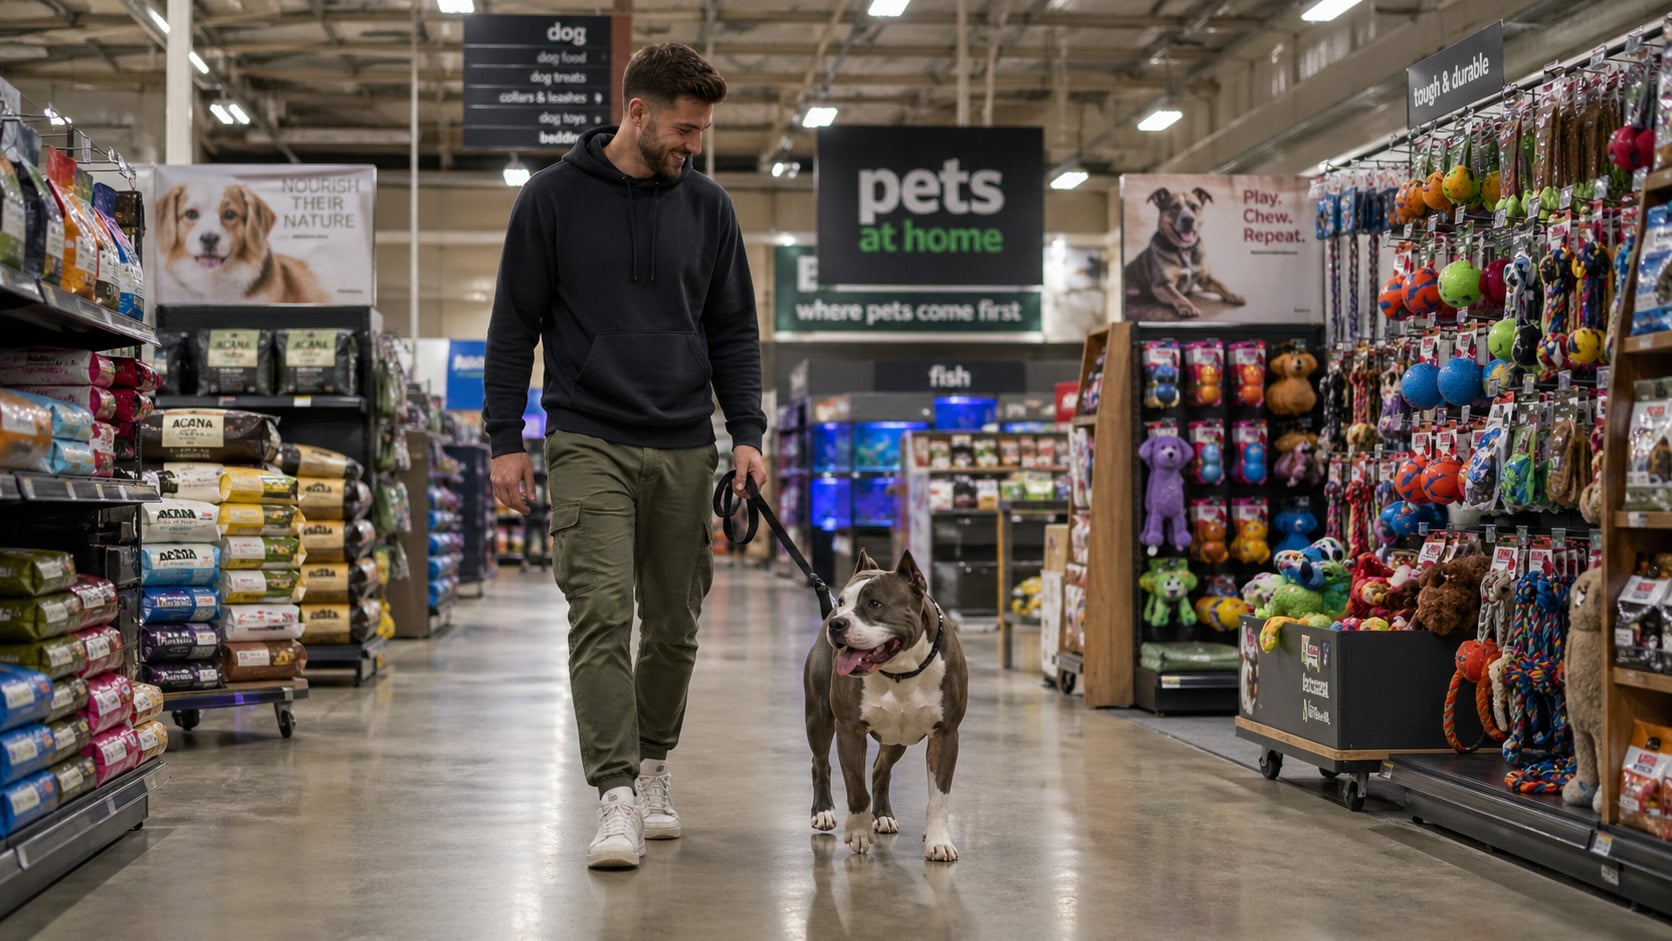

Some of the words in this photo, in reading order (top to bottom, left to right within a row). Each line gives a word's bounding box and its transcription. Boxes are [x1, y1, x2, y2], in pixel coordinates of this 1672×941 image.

[546, 21, 587, 46] dog
[537, 50, 560, 67] dog
[530, 70, 552, 86] dog
[553, 71, 587, 84] treats
[1414, 74, 1440, 107] tough
[1442, 70, 1450, 94] &
[1452, 52, 1489, 89] durable
[499, 91, 534, 104] collars
[536, 90, 545, 104] &
[538, 111, 561, 126] dog
[562, 112, 587, 126] toys
[281, 178, 359, 193] NOURISH
[858, 157, 1005, 225] pets
[291, 196, 343, 210] THEIR
[1243, 189, 1282, 207] Play.
[283, 214, 355, 228] NATURE
[1243, 208, 1293, 224] Chew.
[858, 223, 897, 253] at
[902, 219, 1003, 253] home
[1243, 228, 1306, 246] Repeat.
[796, 299, 863, 322] where
[866, 301, 914, 326] pets
[916, 303, 974, 322] come
[977, 299, 1023, 322] first
[928, 364, 971, 388] fish
[172, 417, 213, 429] ACANA
